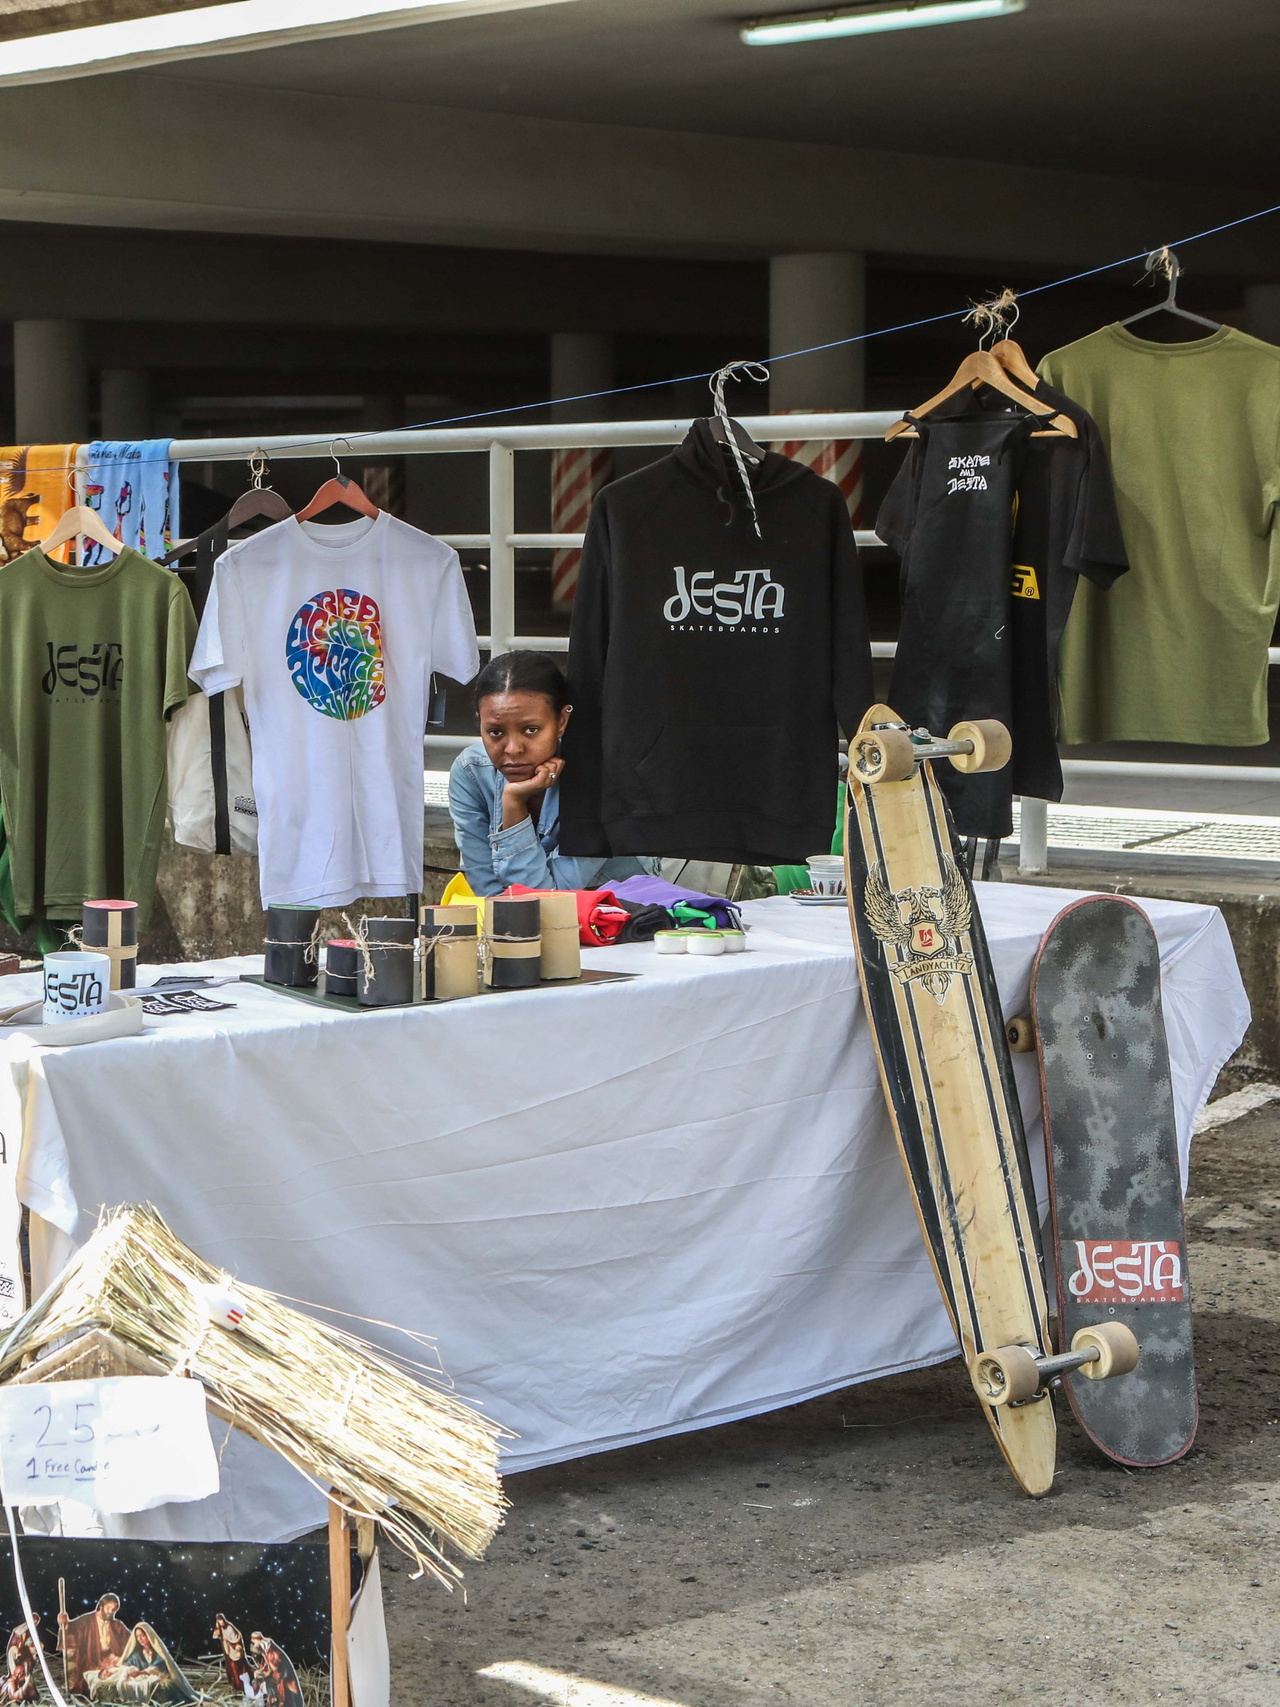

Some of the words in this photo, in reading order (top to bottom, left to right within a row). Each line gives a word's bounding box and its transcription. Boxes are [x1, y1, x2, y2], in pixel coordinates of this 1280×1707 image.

[948, 455, 991, 470] SKATE
[670, 624, 780, 634] SKATEBOARDS
[903, 961, 966, 979] LANDYACHTZ
[1076, 1296, 1177, 1304] SKATEBOARDS
[44, 1458, 70, 1474] Free
